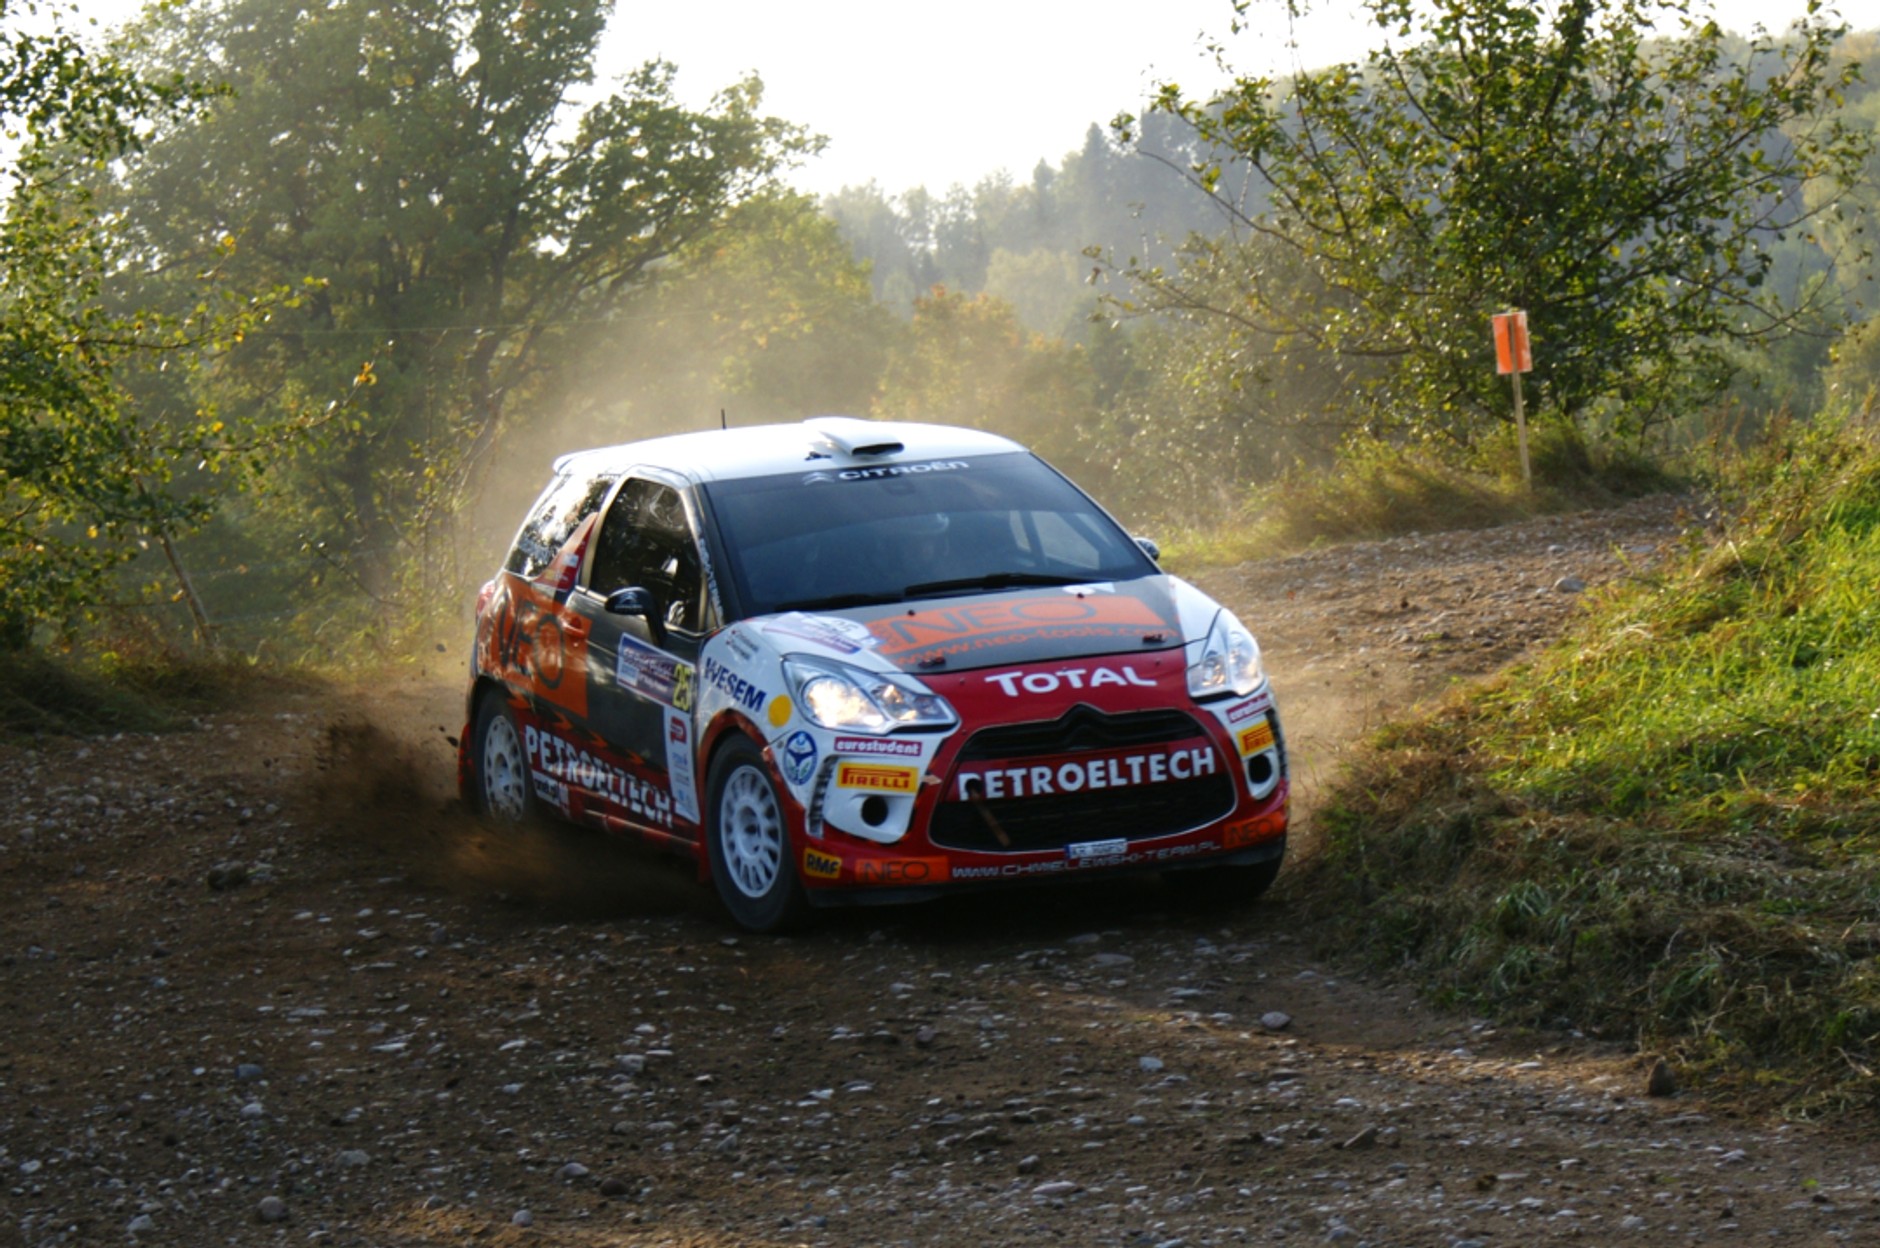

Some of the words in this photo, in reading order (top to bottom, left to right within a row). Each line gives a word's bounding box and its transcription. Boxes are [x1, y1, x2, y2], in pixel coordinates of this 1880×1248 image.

[889, 601, 1097, 645] NEO
[703, 657, 767, 712] WESEM
[985, 666, 1157, 697] TOTAL
[837, 739, 919, 755] eurostudent
[525, 724, 673, 828] PETROELTECH
[841, 767, 911, 789] PIRELLI
[863, 860, 930, 880] NEO
